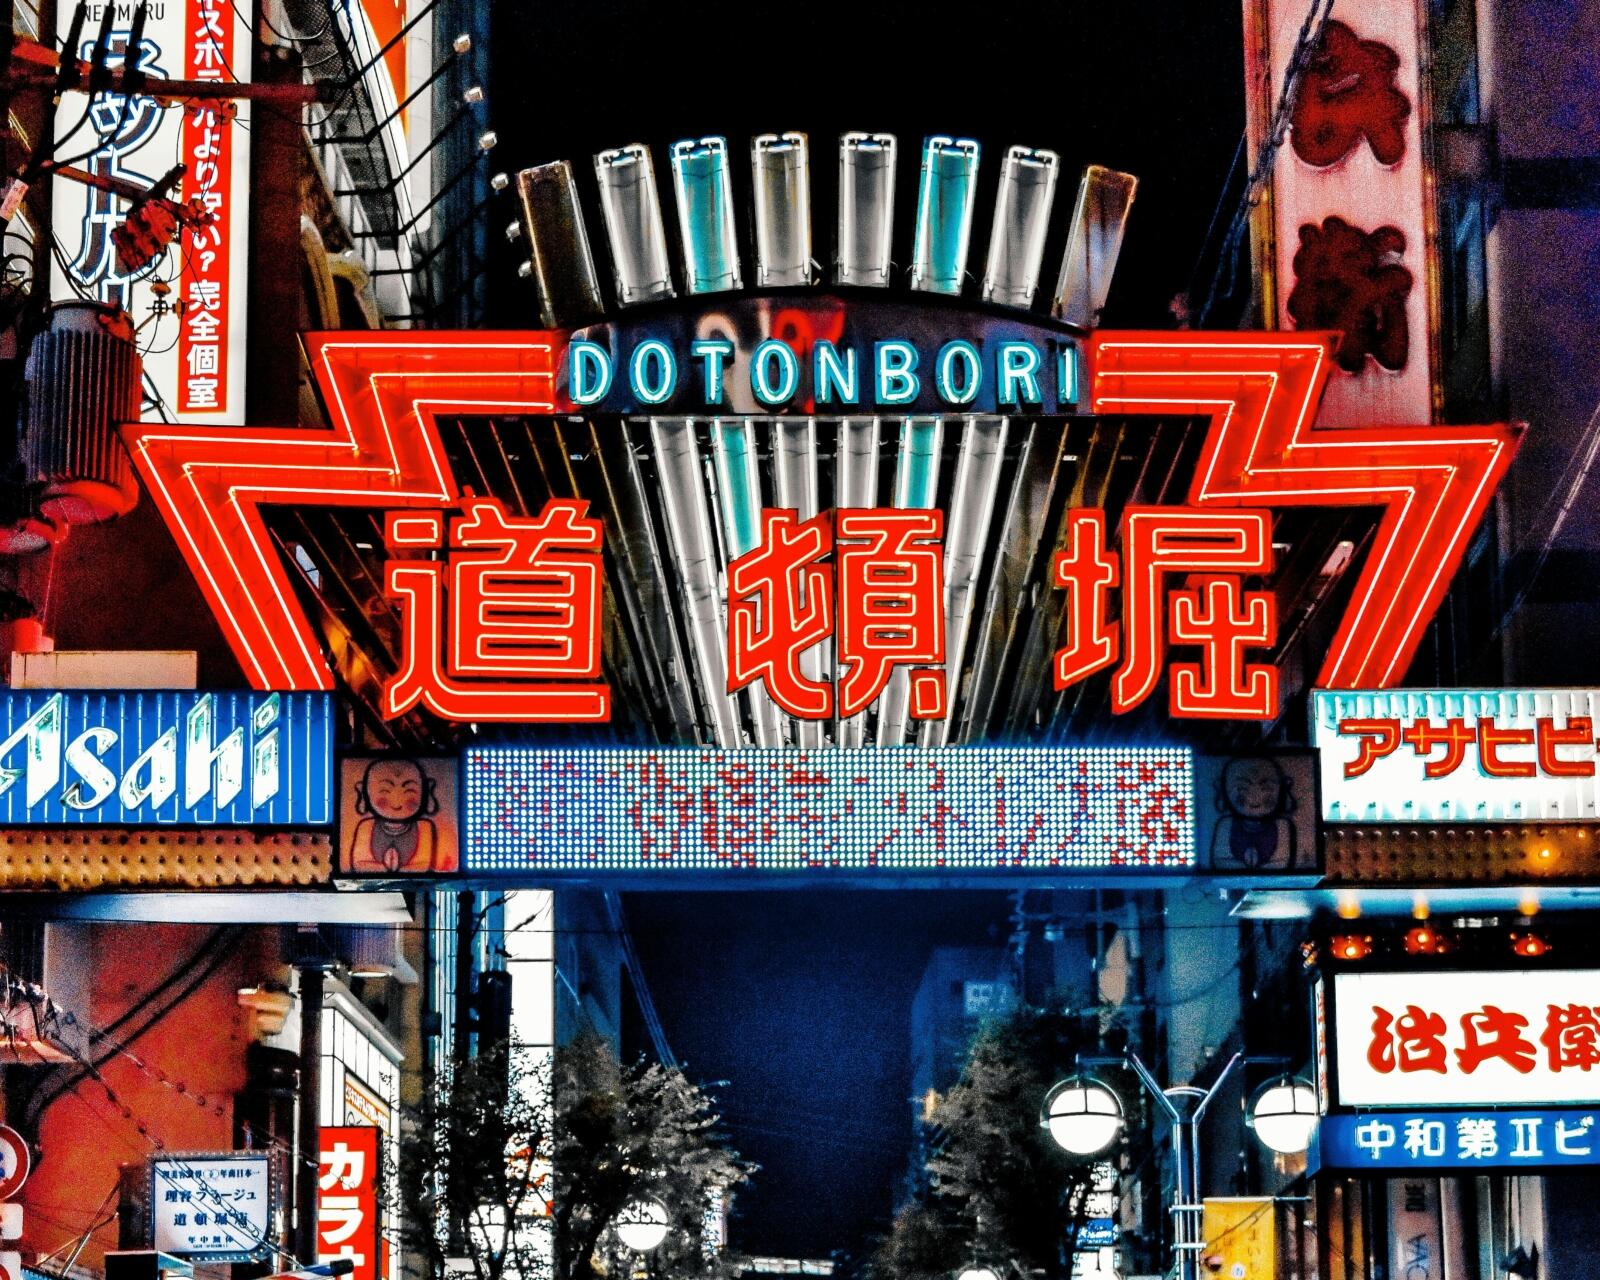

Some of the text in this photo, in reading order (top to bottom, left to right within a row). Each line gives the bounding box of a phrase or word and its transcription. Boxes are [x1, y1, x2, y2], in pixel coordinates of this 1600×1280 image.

[187, 280, 221, 409] 完全個室
[568, 338, 1080, 406] DOTONBORI
[379, 497, 1280, 722] 道頓堀
[0, 692, 281, 810] Asahi
[1338, 716, 1600, 779] アサヒビ
